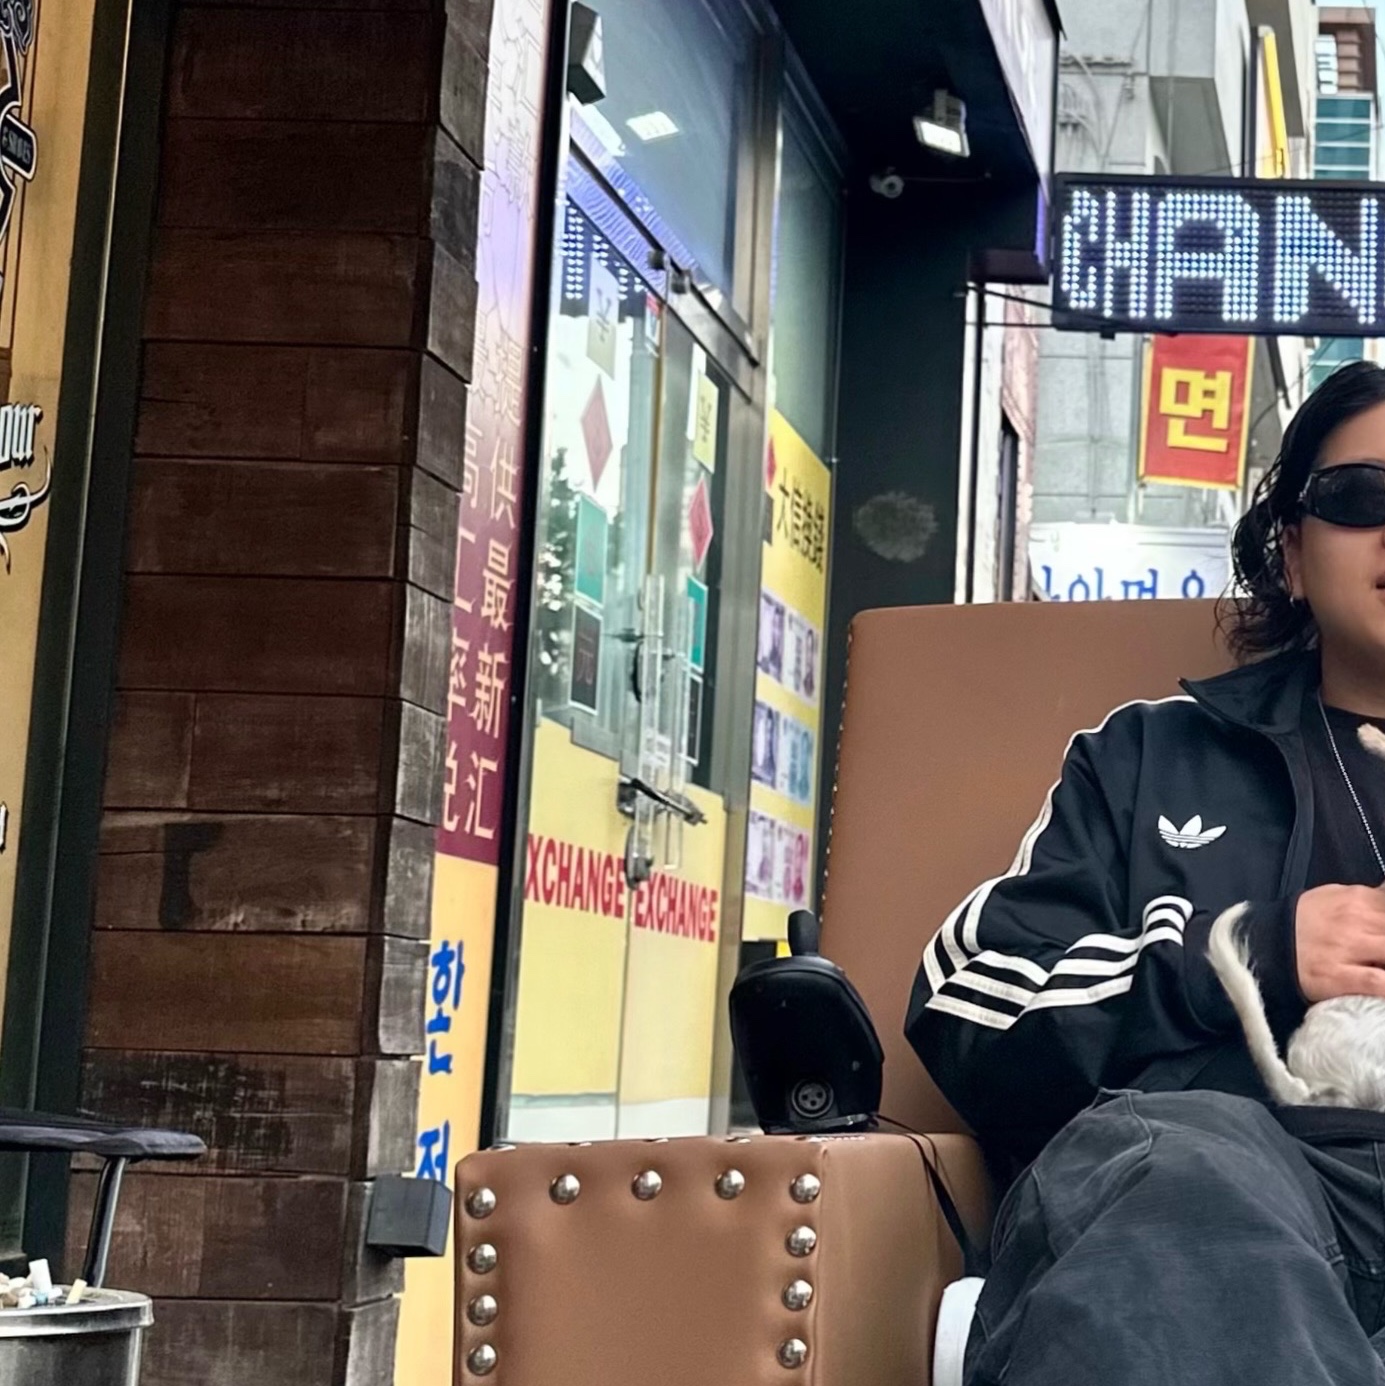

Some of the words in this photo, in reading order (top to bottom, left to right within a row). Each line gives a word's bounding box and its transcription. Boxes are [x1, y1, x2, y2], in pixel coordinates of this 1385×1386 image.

[1159, 366, 1233, 453] 면
[525, 832, 626, 919] XCHANGE
[634, 872, 718, 943] EXCHANGE
